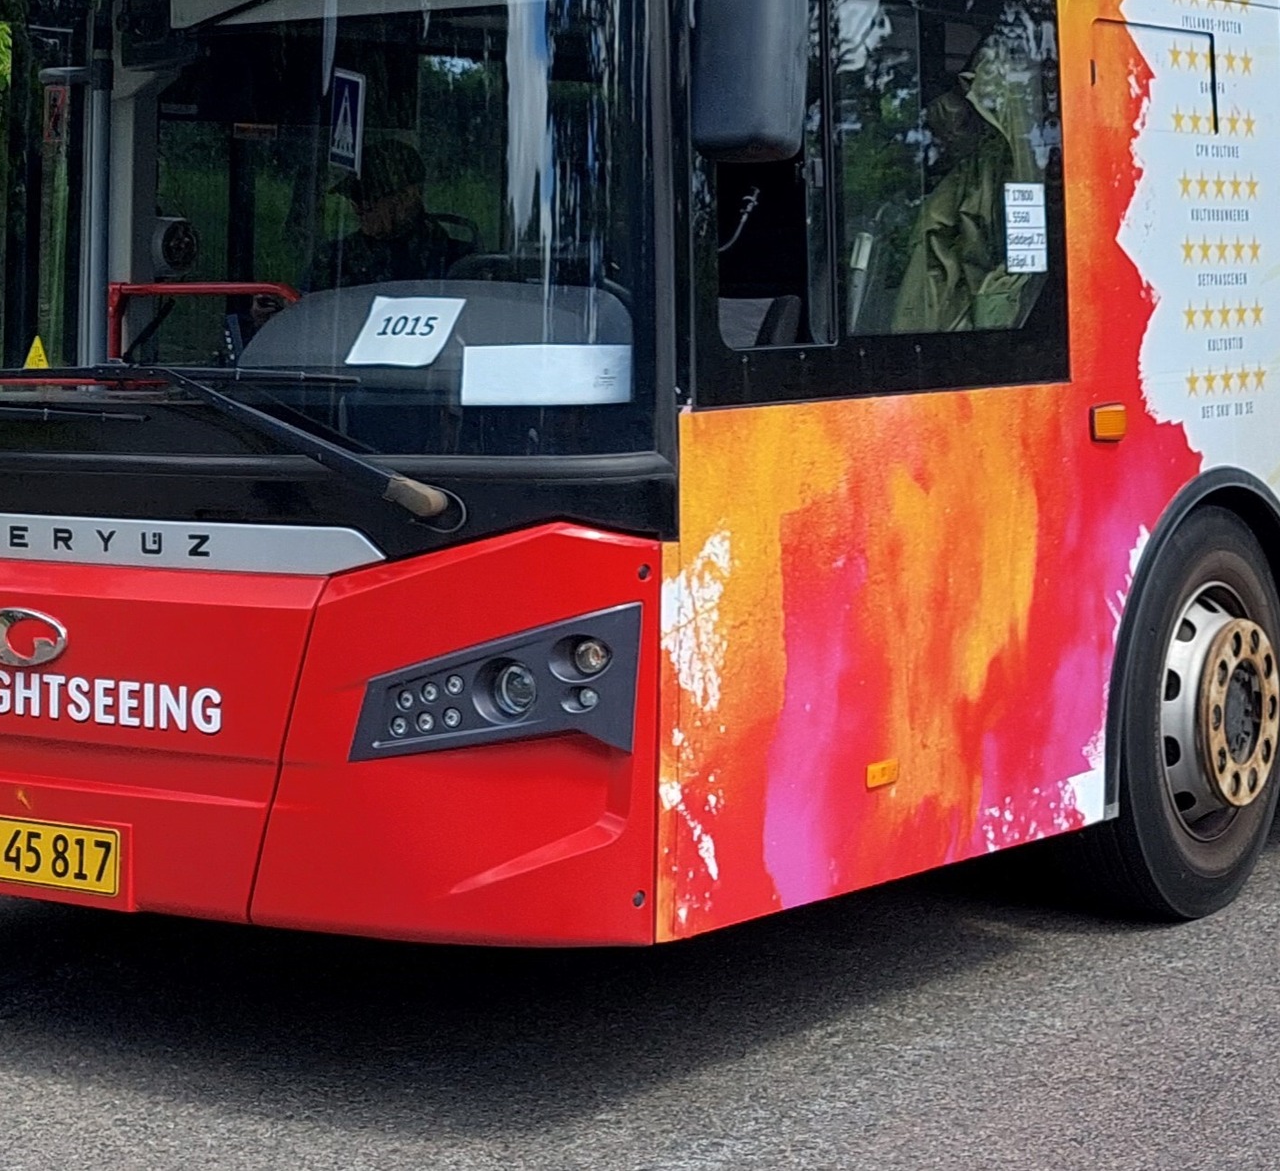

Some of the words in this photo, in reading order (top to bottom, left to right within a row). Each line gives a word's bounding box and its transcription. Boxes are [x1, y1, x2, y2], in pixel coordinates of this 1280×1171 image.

[1181, 15, 1242, 34] JYLLANDS-POSTEN
[1200, 81, 1225, 95] GAFA
[1211, 144, 1240, 160] CULTURE
[376, 315, 438, 336] 1015
[1245, 400, 1254, 413] SE
[4, 829, 42, 874] 45
[51, 833, 112, 883] 817
